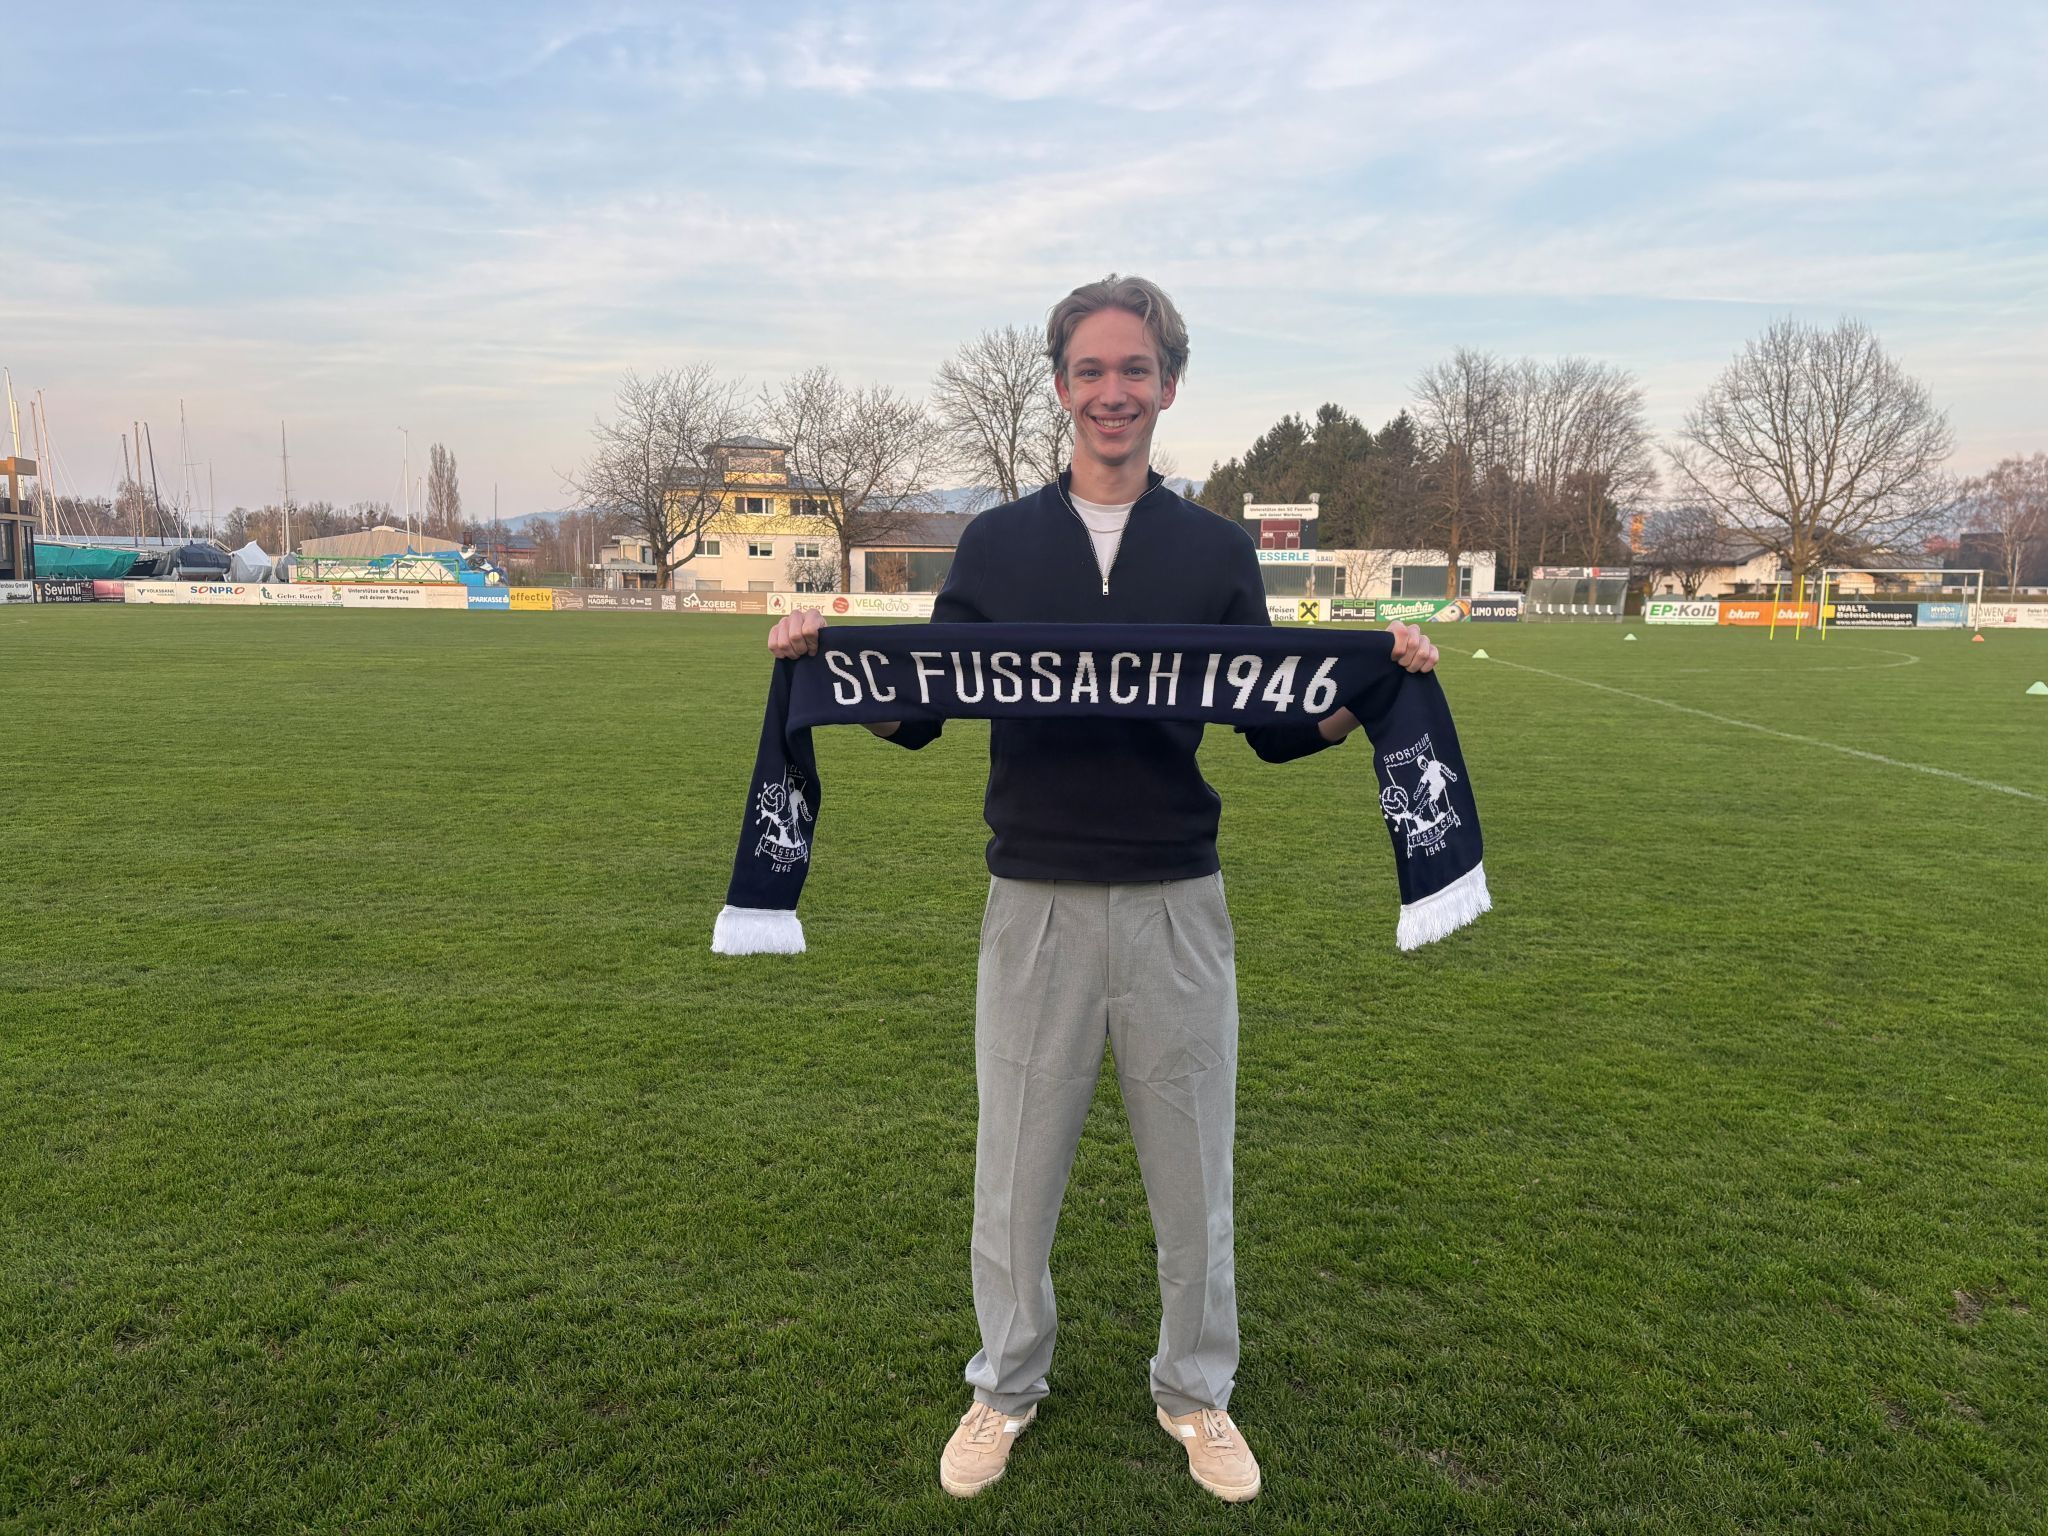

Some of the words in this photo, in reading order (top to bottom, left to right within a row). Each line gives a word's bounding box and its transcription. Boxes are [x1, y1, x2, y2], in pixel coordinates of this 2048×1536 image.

[1257, 552, 1310, 561] ESSERLE
[44, 583, 81, 595] Sevimli
[190, 586, 245, 595] SONPRO
[510, 593, 551, 601] effectiv
[1331, 608, 1376, 617] HAUS
[1471, 607, 1492, 617] LIMO
[1649, 604, 1717, 617] EP:Kolb
[1728, 608, 1760, 620] blum
[1837, 604, 1869, 613] WALTL
[1836, 611, 1913, 619] Beleuchtungen
[824, 650, 897, 705] SC
[909, 650, 1181, 706] FUSSACH
[1201, 653, 1339, 714] 1946
[1383, 732, 1430, 765] SPORTCLUB
[1410, 813, 1453, 845] FUSSACH
[1424, 839, 1447, 857] 1946
[771, 862, 792, 873] 1946
